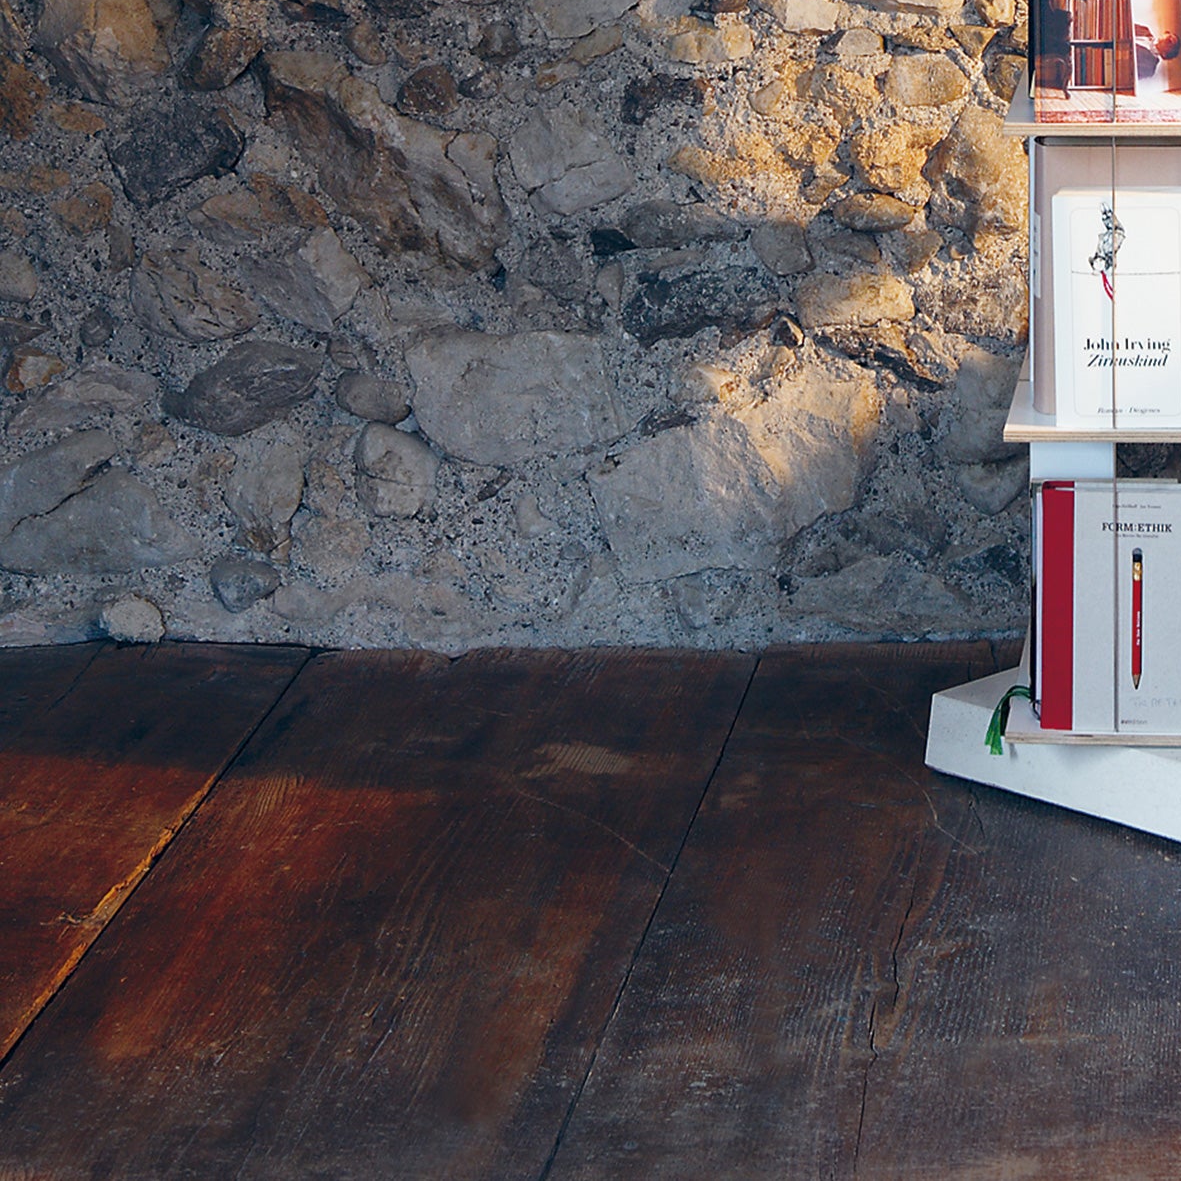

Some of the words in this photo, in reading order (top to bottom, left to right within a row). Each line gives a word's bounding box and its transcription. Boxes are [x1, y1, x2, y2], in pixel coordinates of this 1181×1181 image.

[1083, 338, 1120, 350] John
[1125, 338, 1171, 354] Irving
[1087, 354, 1169, 367] Zirkuskind
[1102, 522, 1172, 533] FORM:ETHIK
